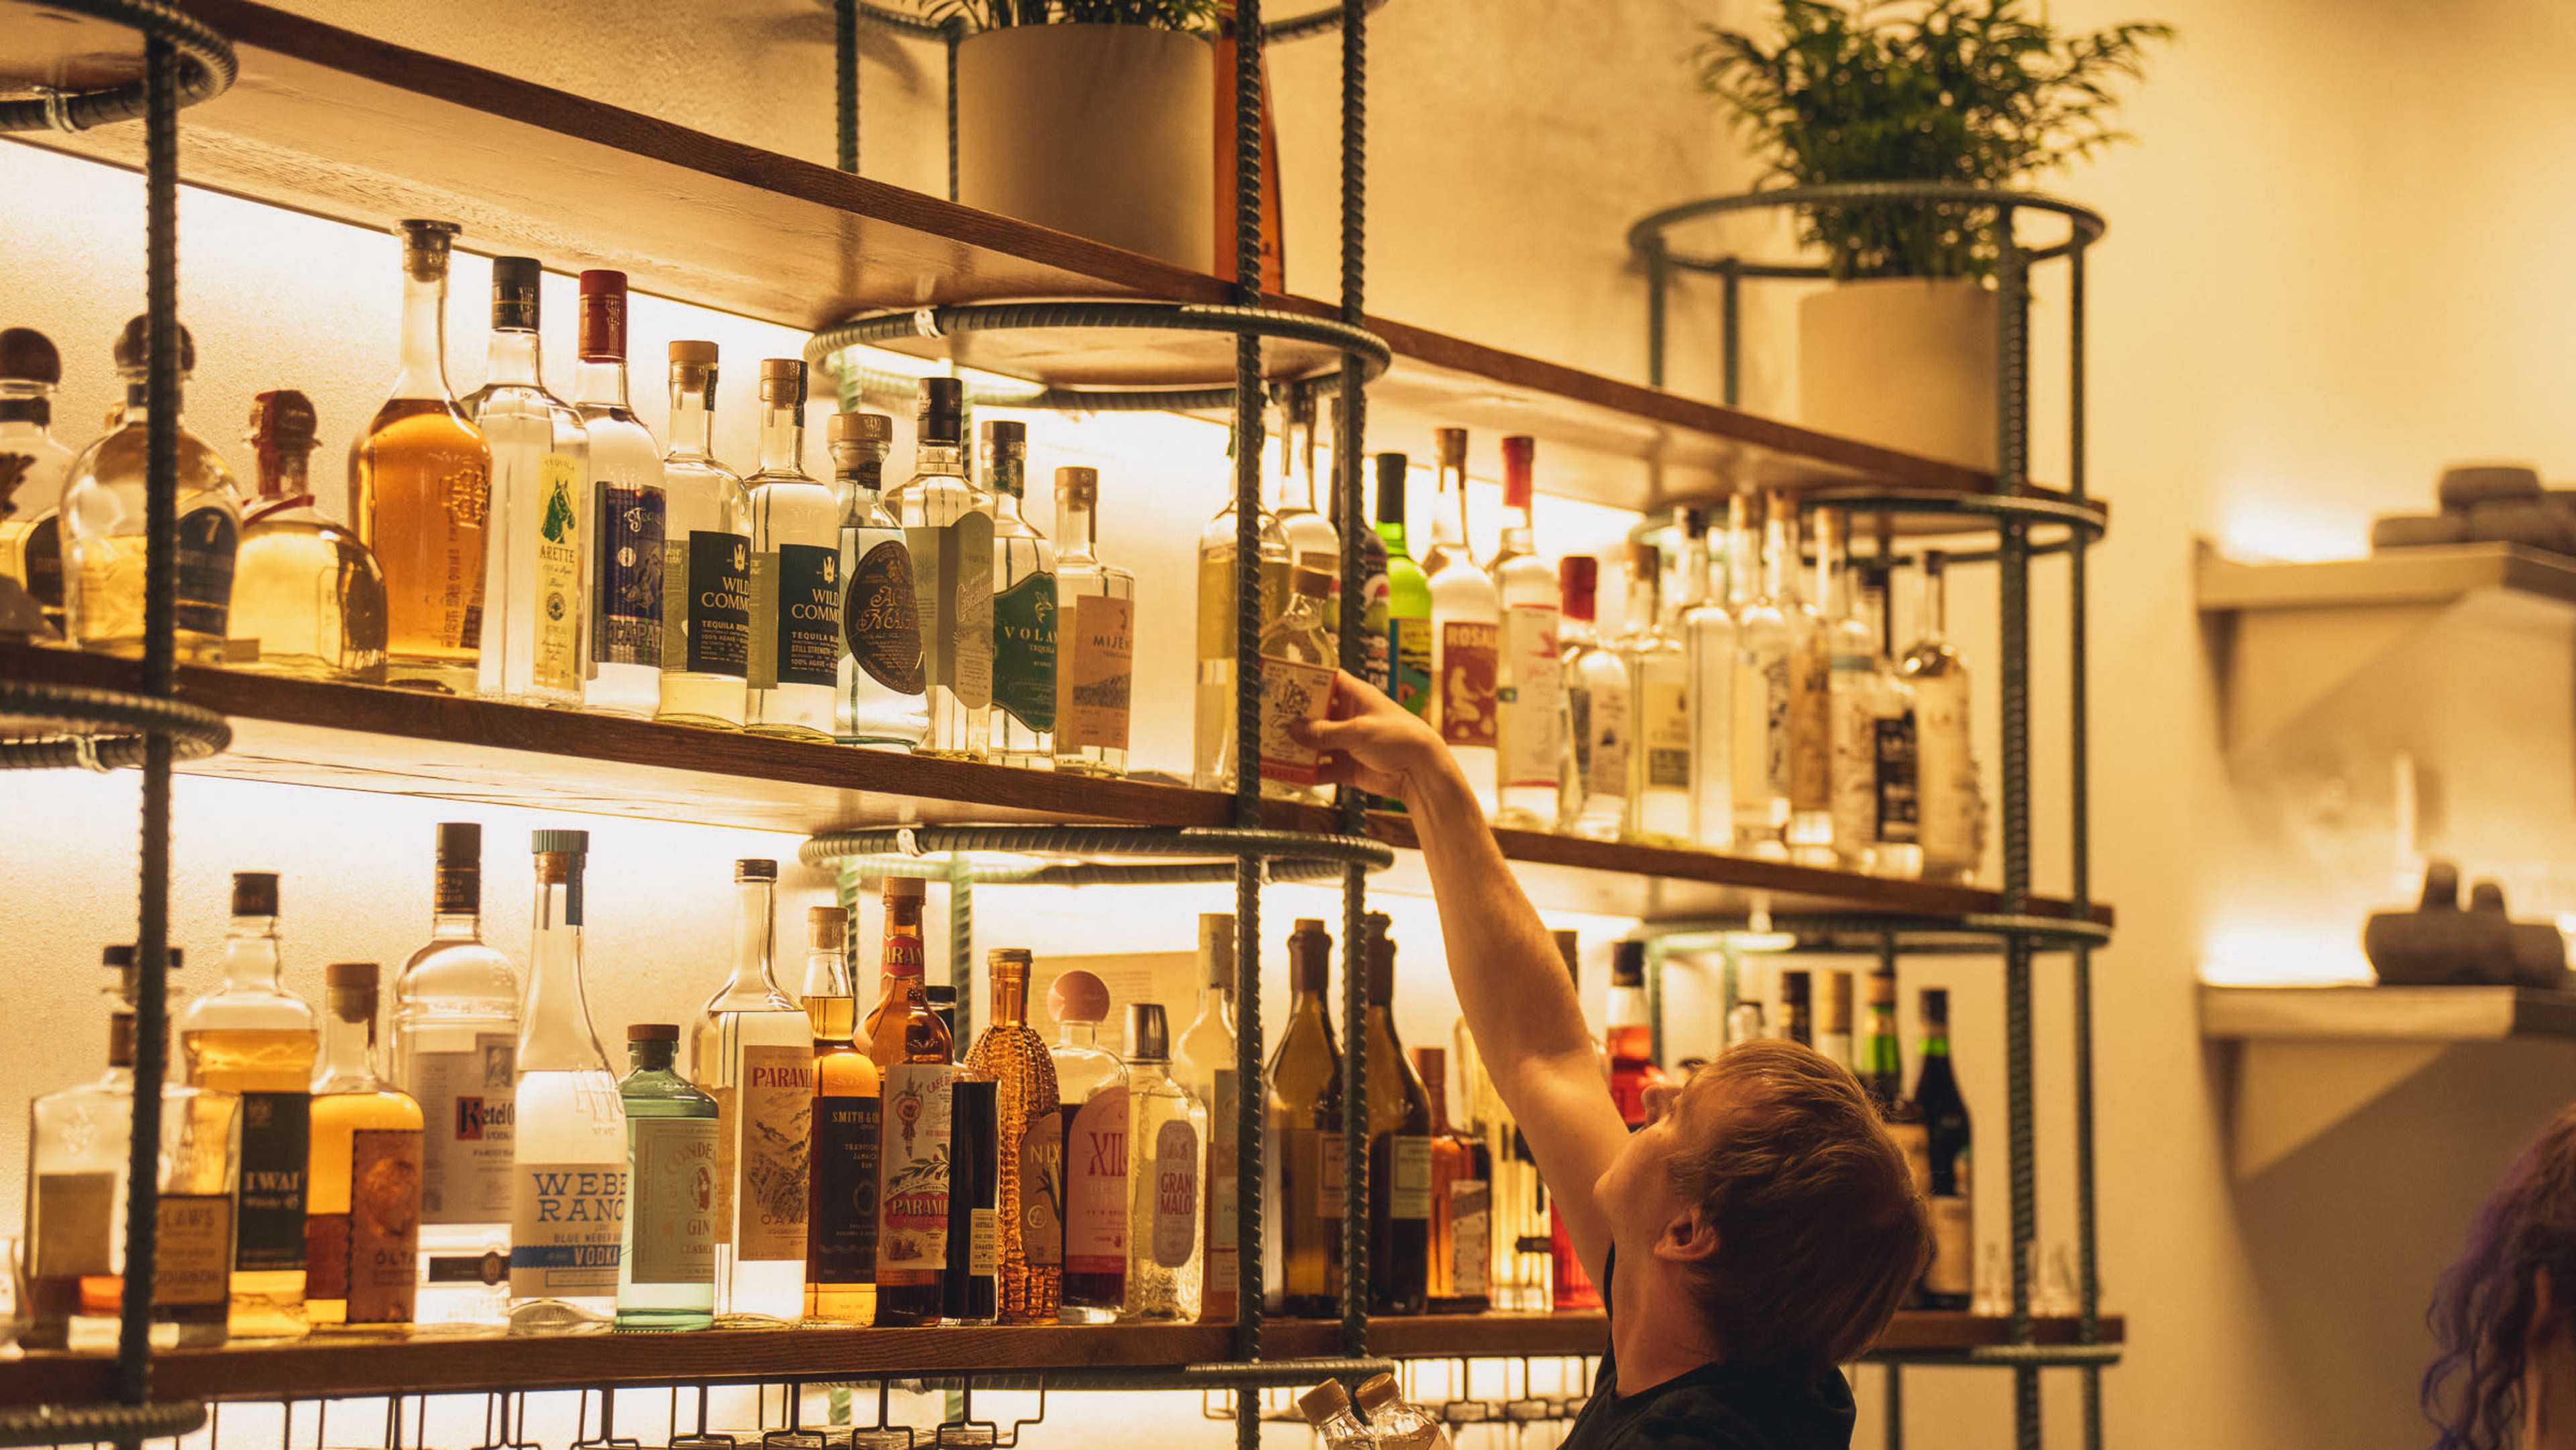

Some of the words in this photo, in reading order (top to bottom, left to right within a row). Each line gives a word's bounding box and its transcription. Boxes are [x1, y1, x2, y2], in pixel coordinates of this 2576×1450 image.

[204, 514, 223, 544] 7
[539, 544, 575, 564] ARETTE
[722, 576, 750, 596] WILD
[812, 588, 839, 607] WILD
[702, 620, 735, 630] TEQUILA
[791, 632, 828, 641] TEQUILA
[460, 1101, 506, 1133] Ketel
[832, 1111, 864, 1123] SMITH
[1160, 1172, 1193, 1194] GRAN
[1160, 1194, 1193, 1215] MALO
[686, 1218, 710, 1236] GIN
